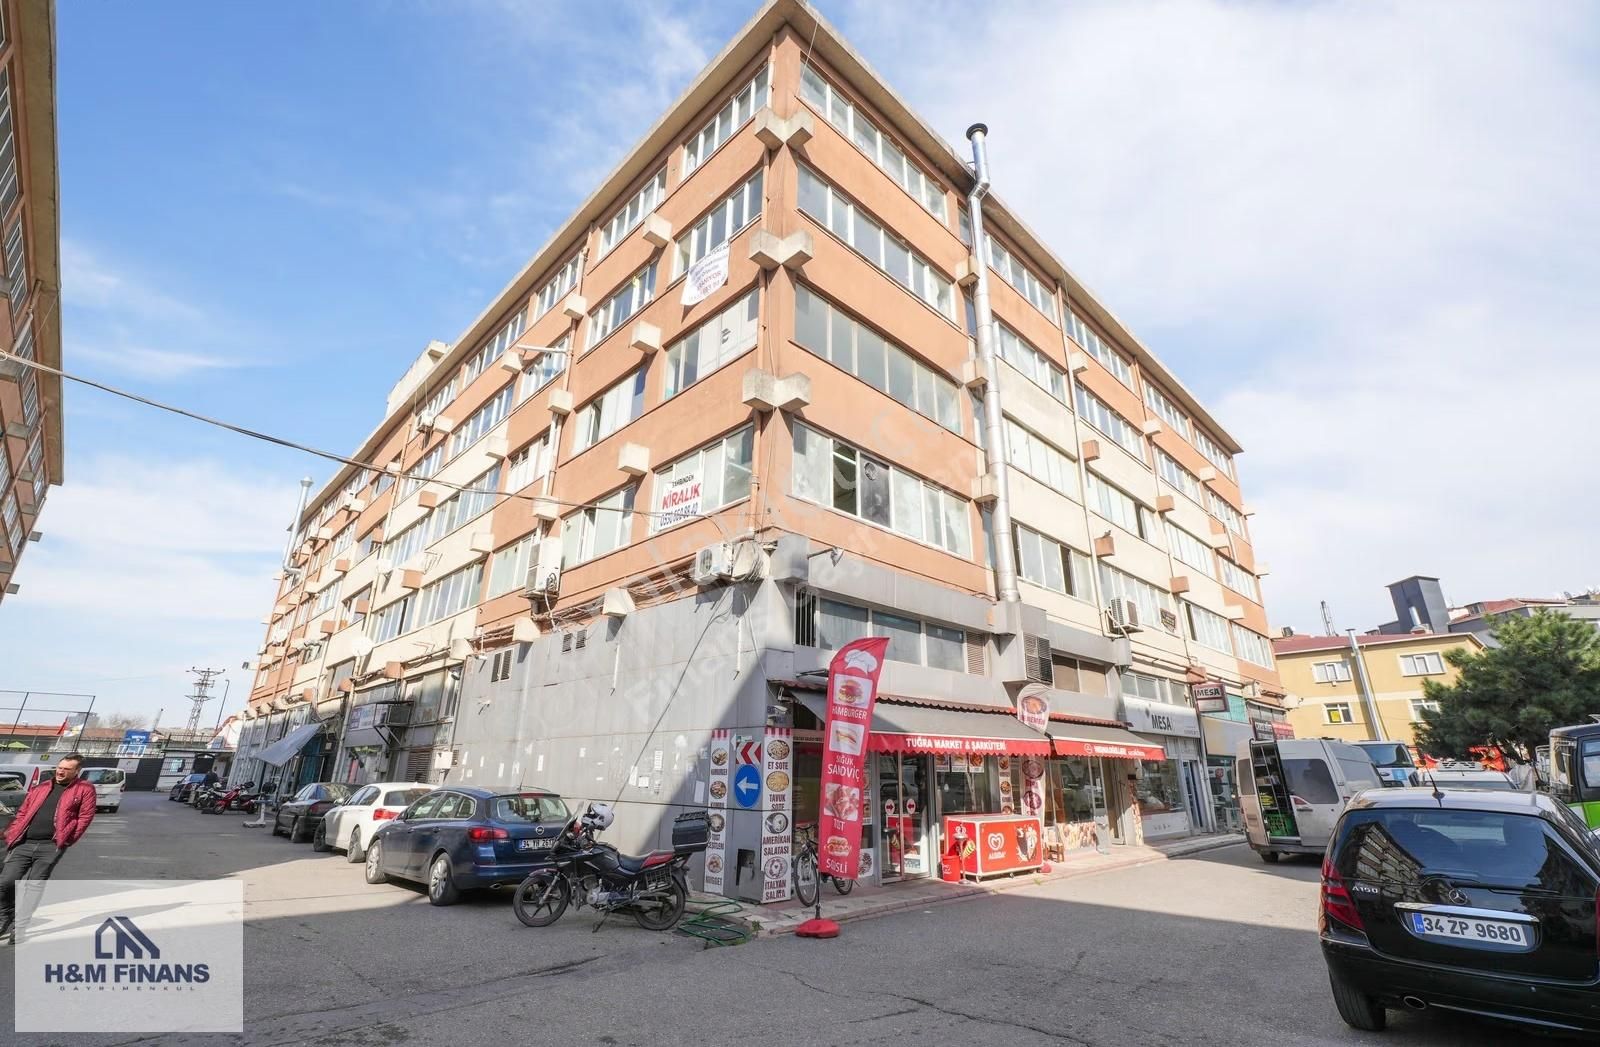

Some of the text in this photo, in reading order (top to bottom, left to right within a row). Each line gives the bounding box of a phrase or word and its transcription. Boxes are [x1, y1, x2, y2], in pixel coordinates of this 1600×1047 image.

[662, 482, 701, 510] KİRALIK
[1197, 688, 1220, 696] MESA
[832, 706, 867, 720] HAMBURGER
[1152, 714, 1172, 730] MESA
[906, 737, 932, 748] TUĞRA
[934, 740, 962, 750] MARKET
[768, 762, 788, 770] ET SOTE
[770, 794, 786, 802] TAVUK
[764, 846, 789, 856] SALATASI
[1423, 918, 1444, 932] 34
[1447, 920, 1470, 936] ZP
[1475, 923, 1522, 942] 9680
